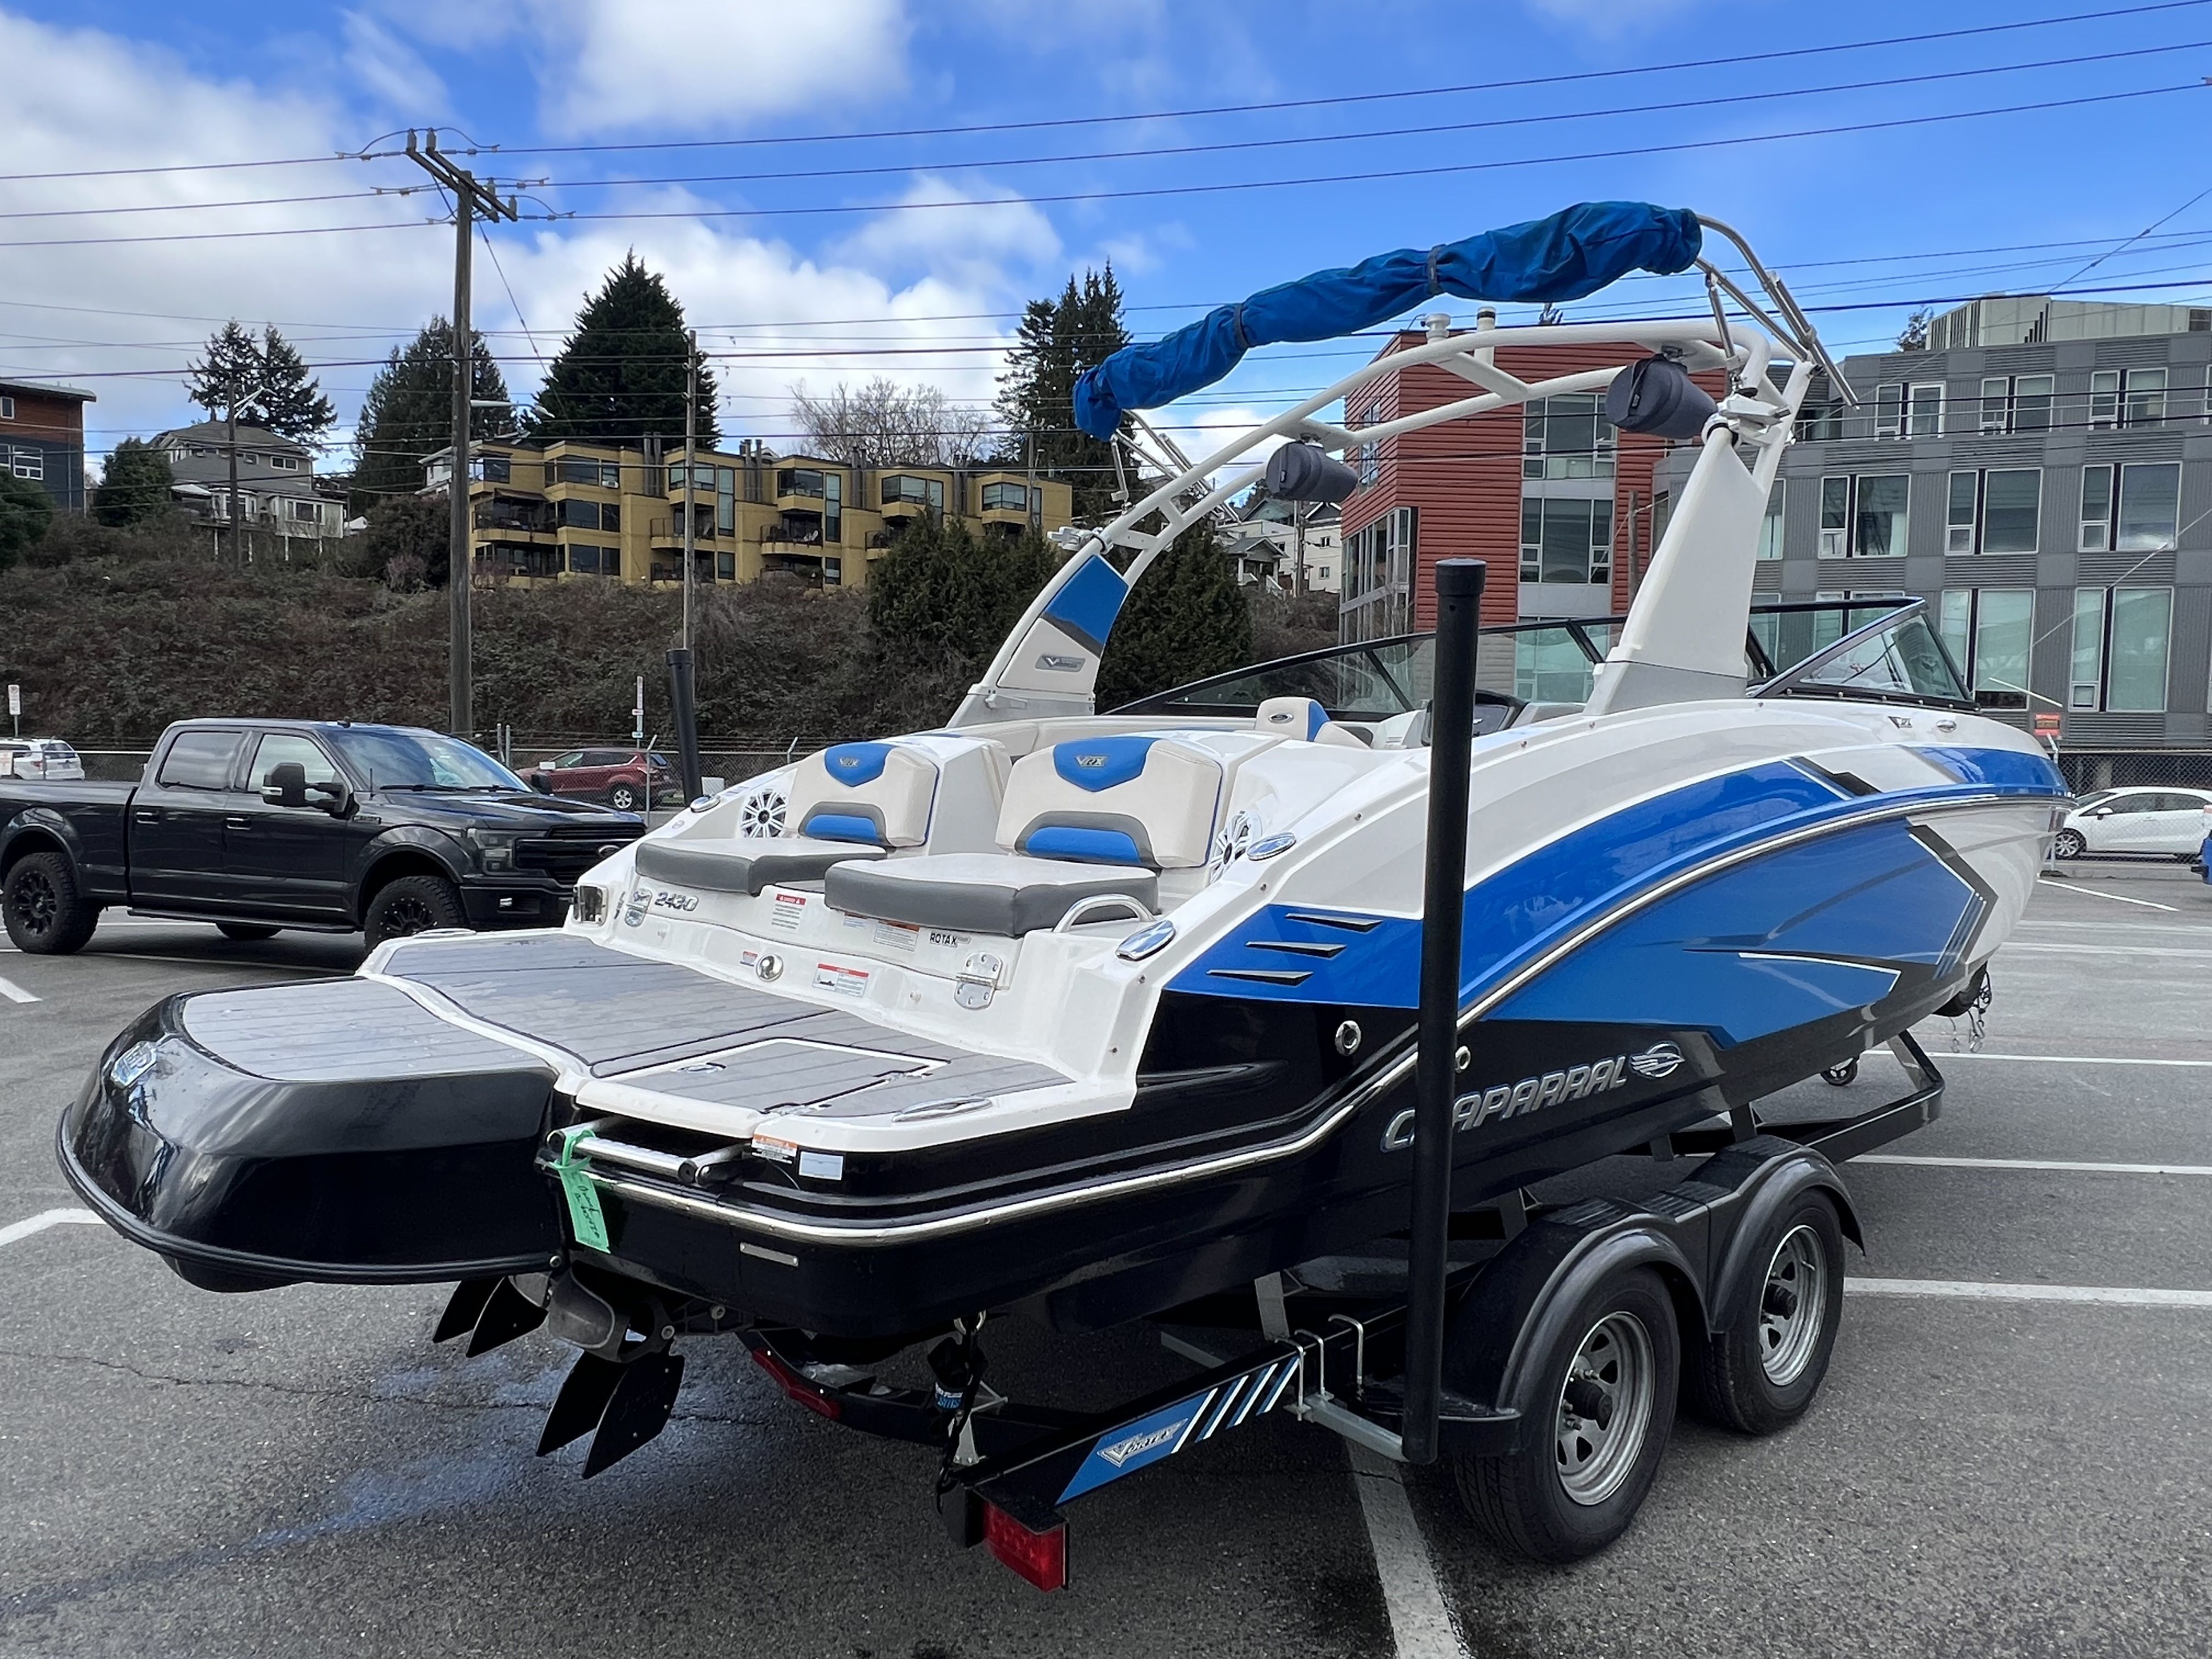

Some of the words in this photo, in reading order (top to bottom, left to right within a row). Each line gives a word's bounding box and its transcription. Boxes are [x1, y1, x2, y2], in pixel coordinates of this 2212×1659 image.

[654, 892, 699, 911] 2430
[929, 932, 958, 947] ROTAX
[1380, 1054, 1628, 1152] CAPARRAL
